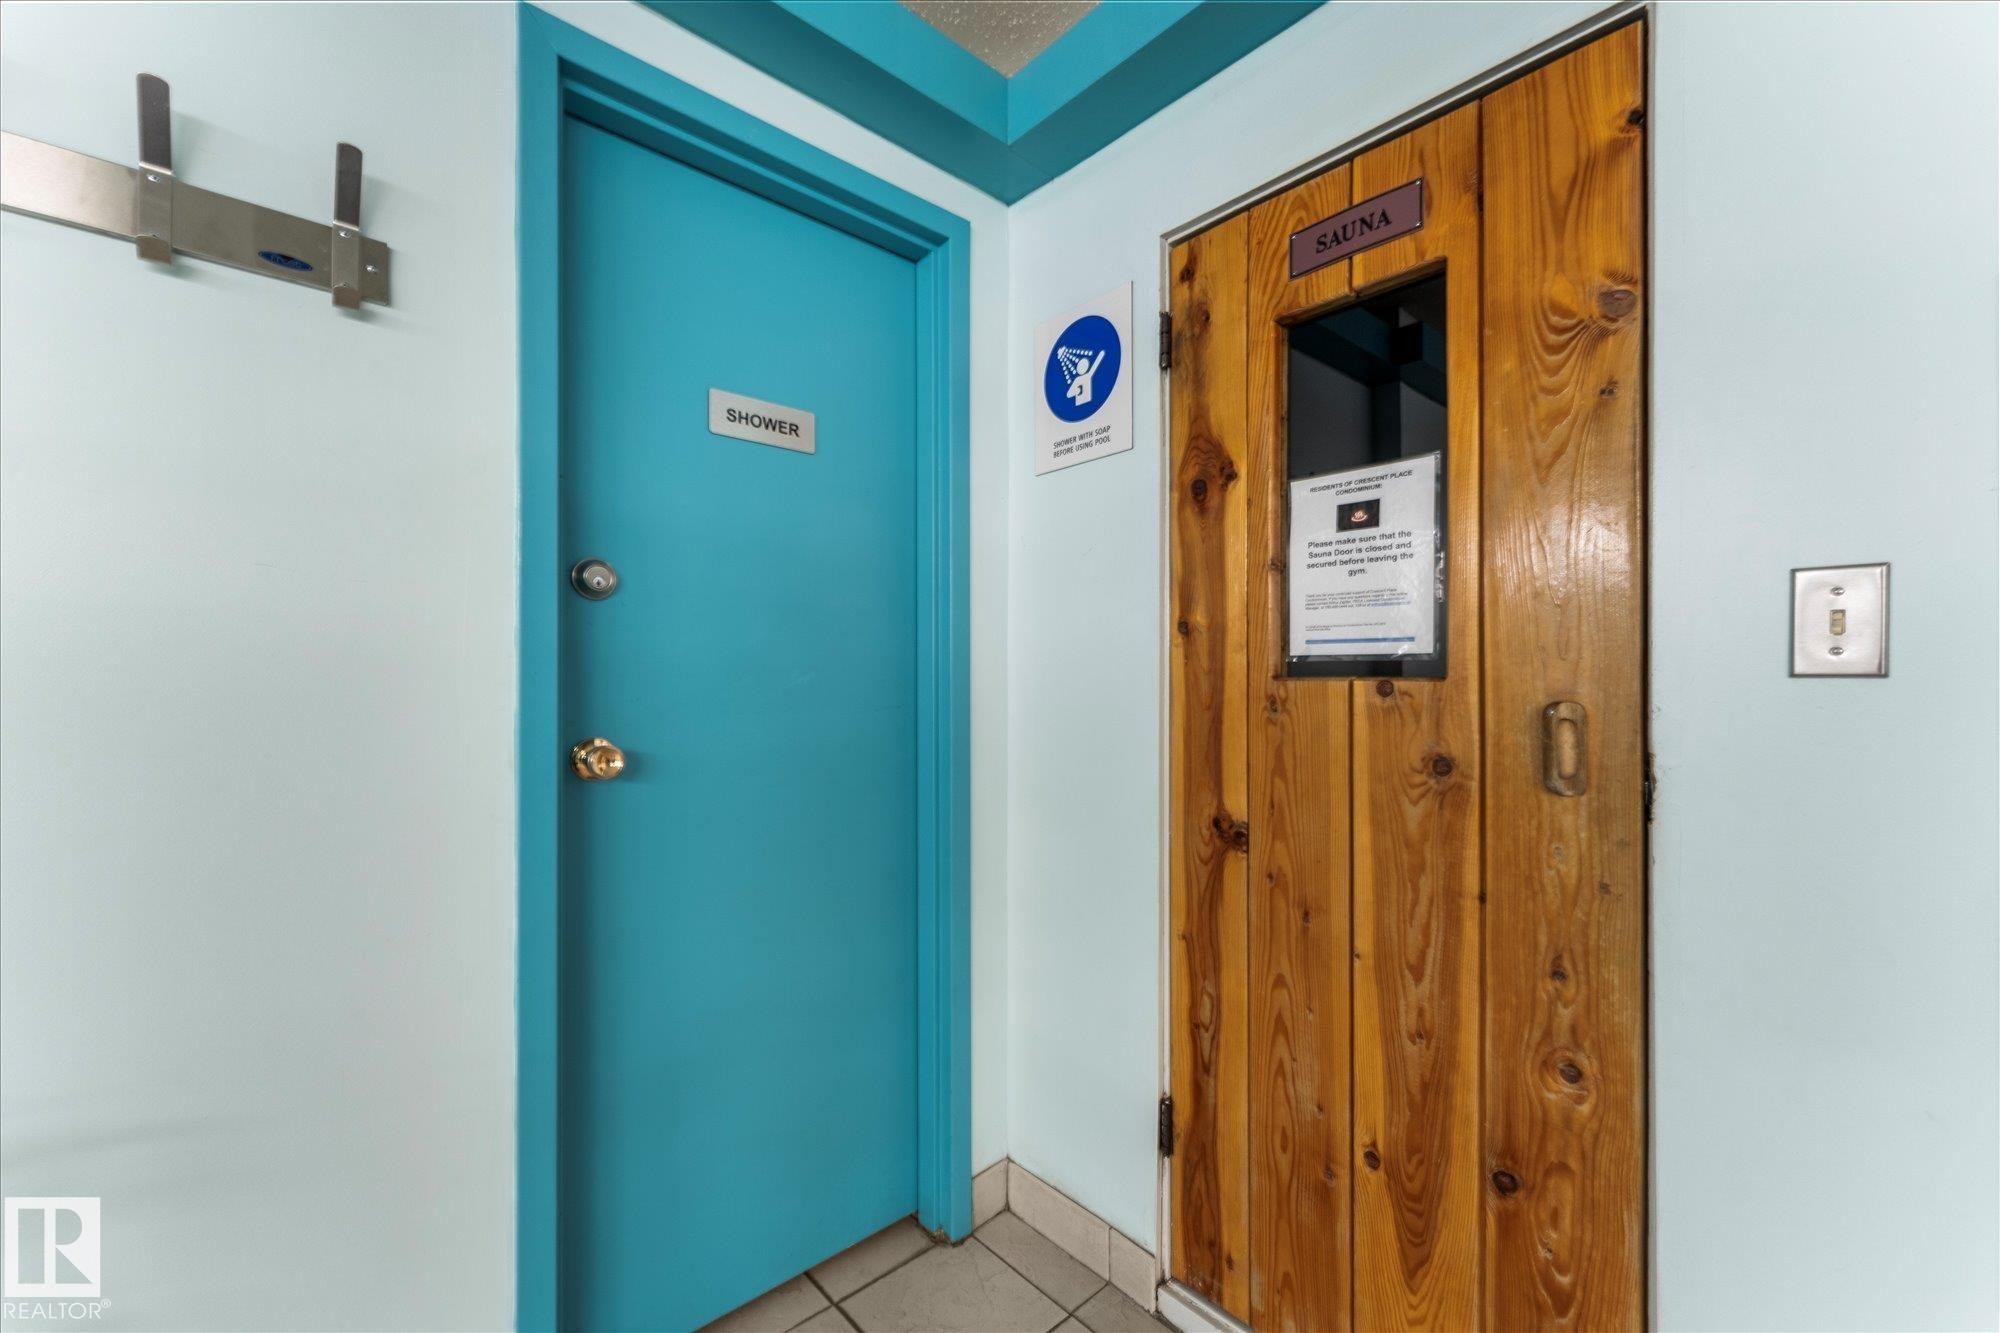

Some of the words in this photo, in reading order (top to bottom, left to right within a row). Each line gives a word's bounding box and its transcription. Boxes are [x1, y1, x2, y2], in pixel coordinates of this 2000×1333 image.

[1316, 208, 1392, 254] SAUNA
[726, 408, 800, 438] SHOWER
[1053, 436, 1077, 449] SHOWER
[1078, 431, 1093, 441] WITH
[1094, 425, 1111, 436] SOAP
[1053, 446, 1074, 458] BEFORE
[1075, 440, 1093, 452] USING
[1094, 435, 1111, 445] POOL
[1310, 483, 1343, 493] RESIDENTS
[1344, 480, 1353, 488] OF
[1354, 473, 1388, 485] CRESCENT
[1389, 469, 1413, 479] PLACE
[1308, 541, 1333, 549] Please
[1335, 537, 1357, 546] make
[1358, 535, 1377, 543] sure
[1379, 532, 1396, 540] that
[1398, 530, 1412, 538] the
[1308, 551, 1332, 559] Sauna
[1334, 548, 1353, 557] Door
[1365, 543, 1393, 552] closed
[1395, 541, 1412, 549] and
[1306, 559, 1337, 569] secured
[1339, 556, 1365, 566] before
[1367, 554, 1398, 563] leaving
[1399, 552, 1414, 560] the
[1347, 568, 1368, 577] gym.
